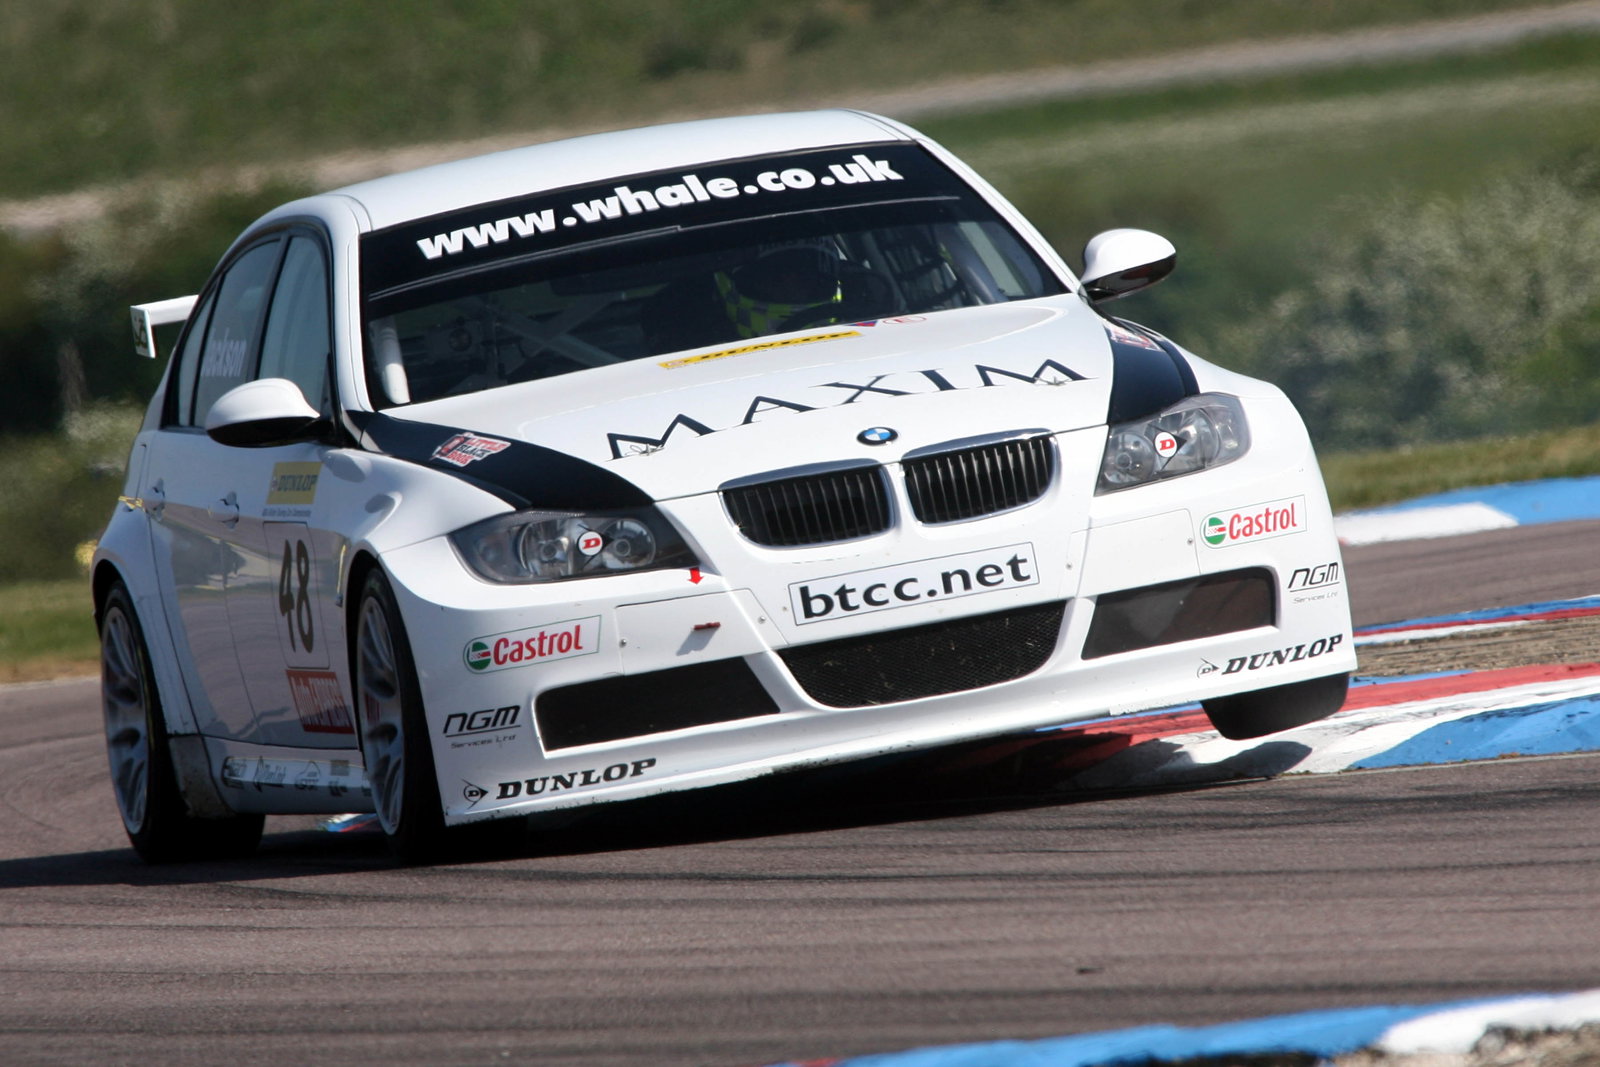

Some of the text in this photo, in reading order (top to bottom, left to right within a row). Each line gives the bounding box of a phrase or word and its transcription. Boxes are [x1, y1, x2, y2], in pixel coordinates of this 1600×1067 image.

[417, 154, 905, 260] www.whale.co.uk
[605, 359, 1099, 462] MAXIM
[277, 474, 319, 492] DUNLOP
[1229, 502, 1297, 540] Castrol
[279, 539, 314, 654] 48
[799, 553, 1031, 619] btcc.net
[493, 624, 583, 666] Castrol
[1221, 634, 1343, 675] DUNLOP
[450, 738, 493, 750] Services
[496, 758, 657, 800] DUNLOP
